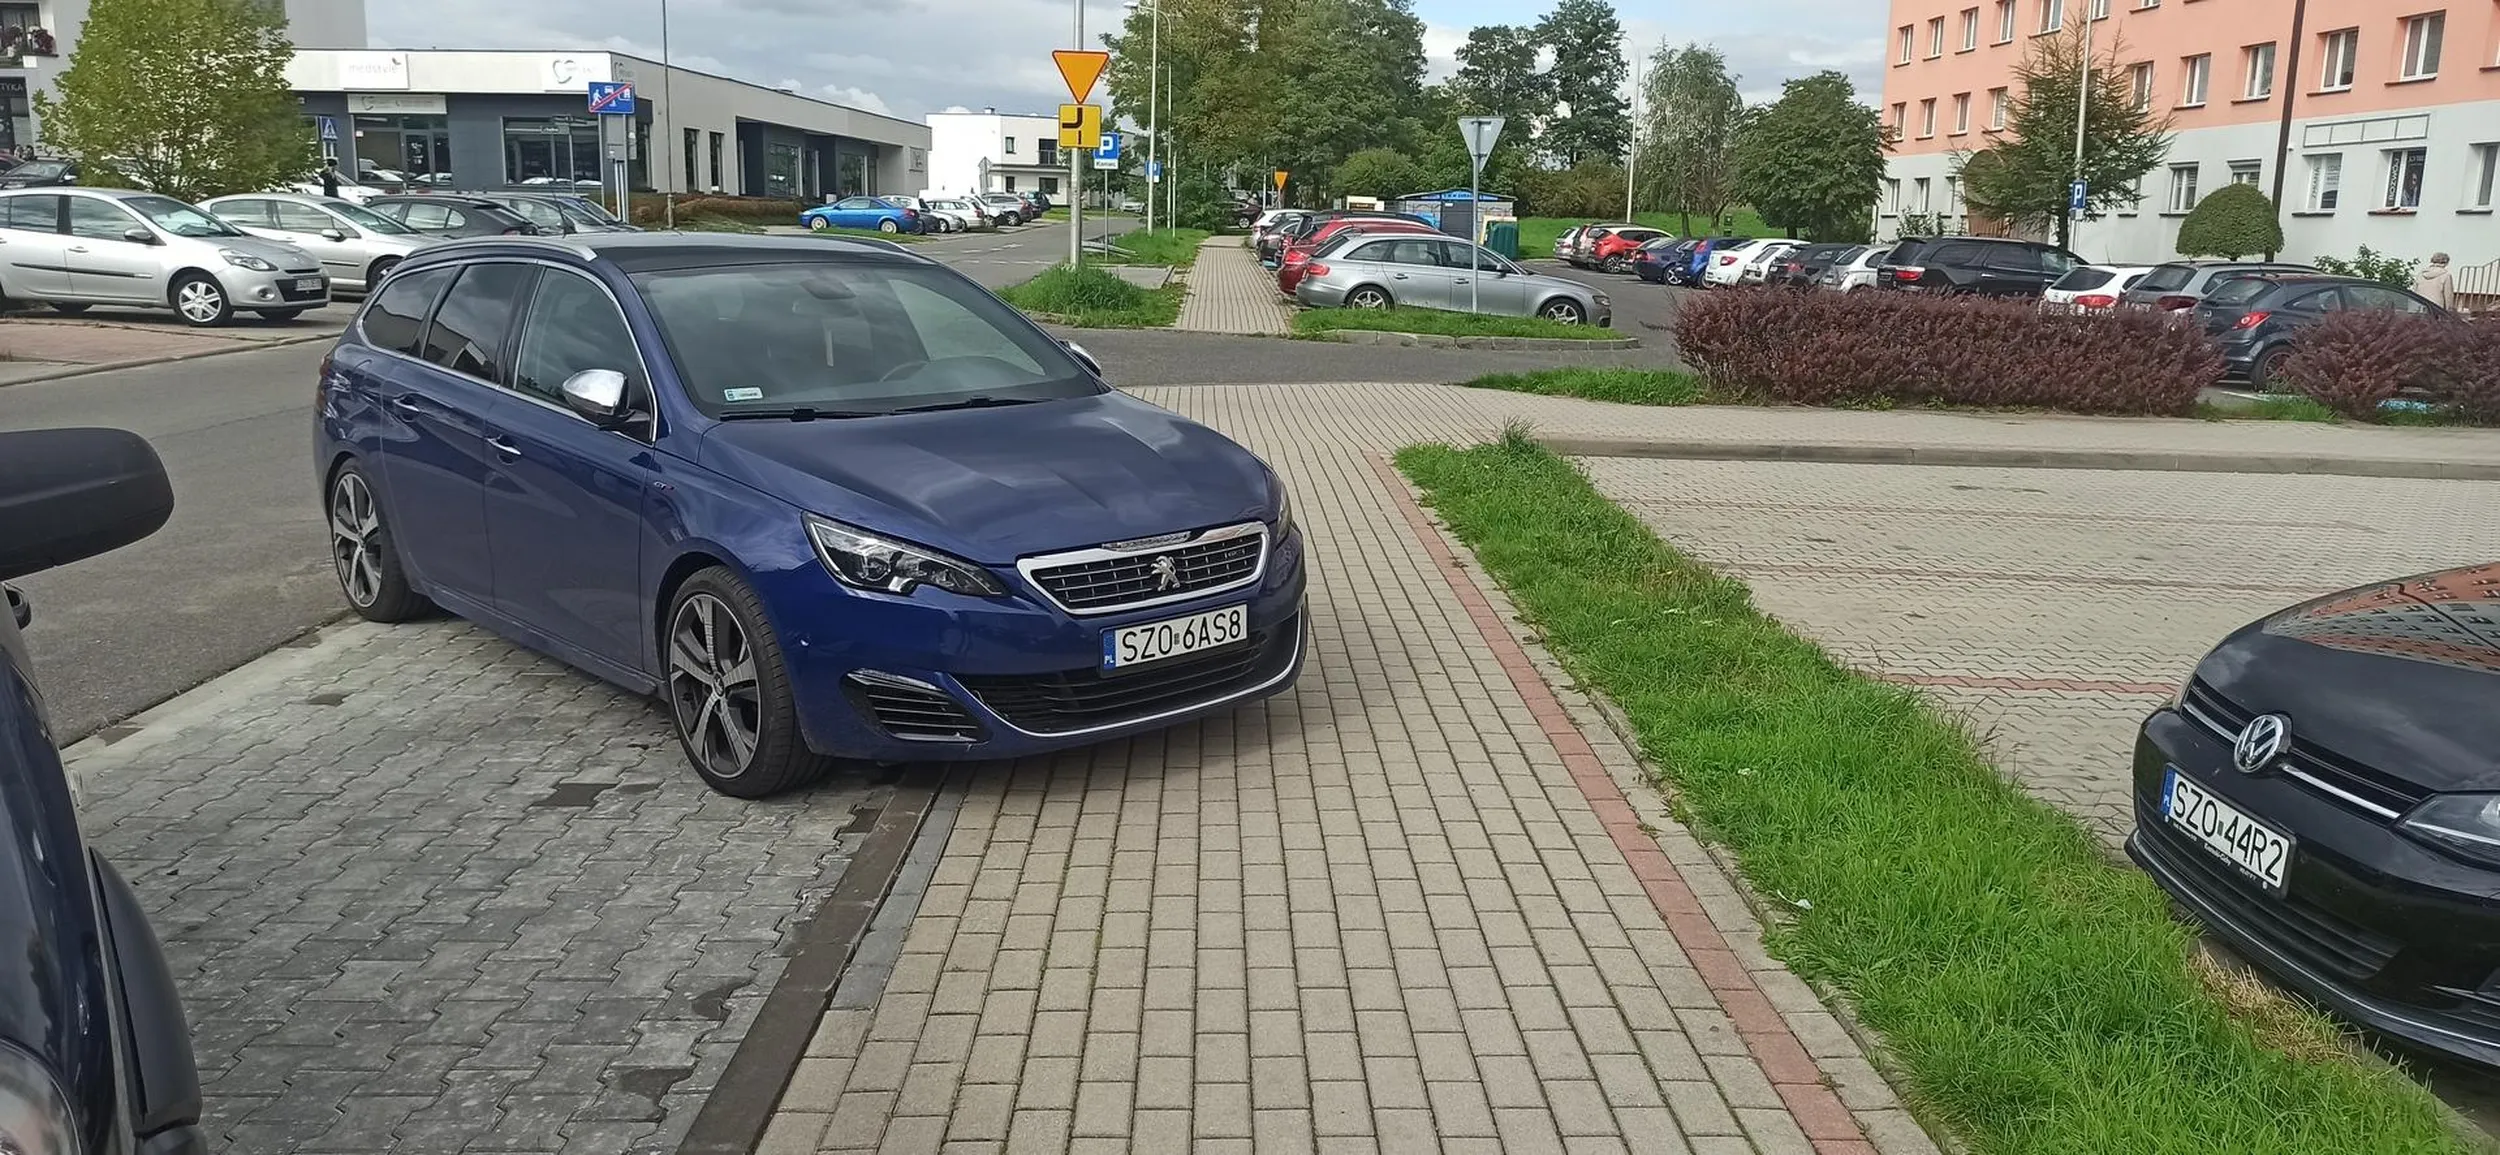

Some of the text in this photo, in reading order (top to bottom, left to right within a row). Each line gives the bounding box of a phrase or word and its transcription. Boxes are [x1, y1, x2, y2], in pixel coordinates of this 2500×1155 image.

[1099, 136, 1114, 156] P
[2073, 184, 2083, 206] P
[1122, 610, 1241, 662] SZO 6AS8
[1104, 655, 1115, 665] PL
[2173, 781, 2283, 882] SZO 44R2
